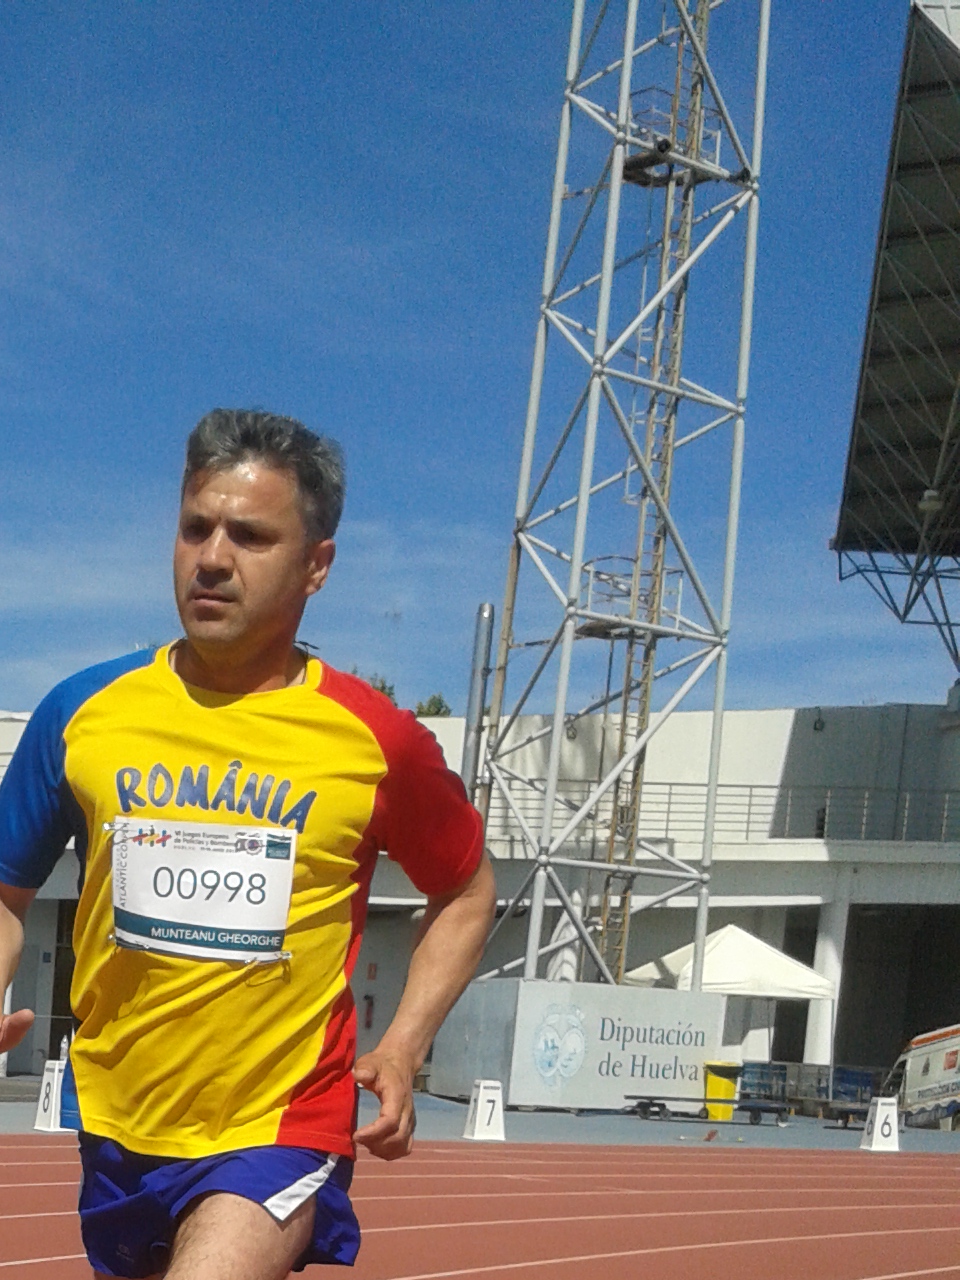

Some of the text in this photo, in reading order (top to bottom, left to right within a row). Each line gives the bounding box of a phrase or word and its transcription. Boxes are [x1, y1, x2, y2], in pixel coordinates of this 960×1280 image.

[116, 760, 317, 834] ROMÂNIA
[119, 861, 128, 908] ATLANTIC
[152, 866, 267, 906] 00998
[151, 926, 281, 947] MUNTEANU GHEORGHE
[600, 1016, 705, 1051] Diputación
[598, 1052, 699, 1081] de Huelva
[43, 1081, 51, 1113] 8
[486, 1099, 496, 1126] 7
[881, 1114, 892, 1138] 6
